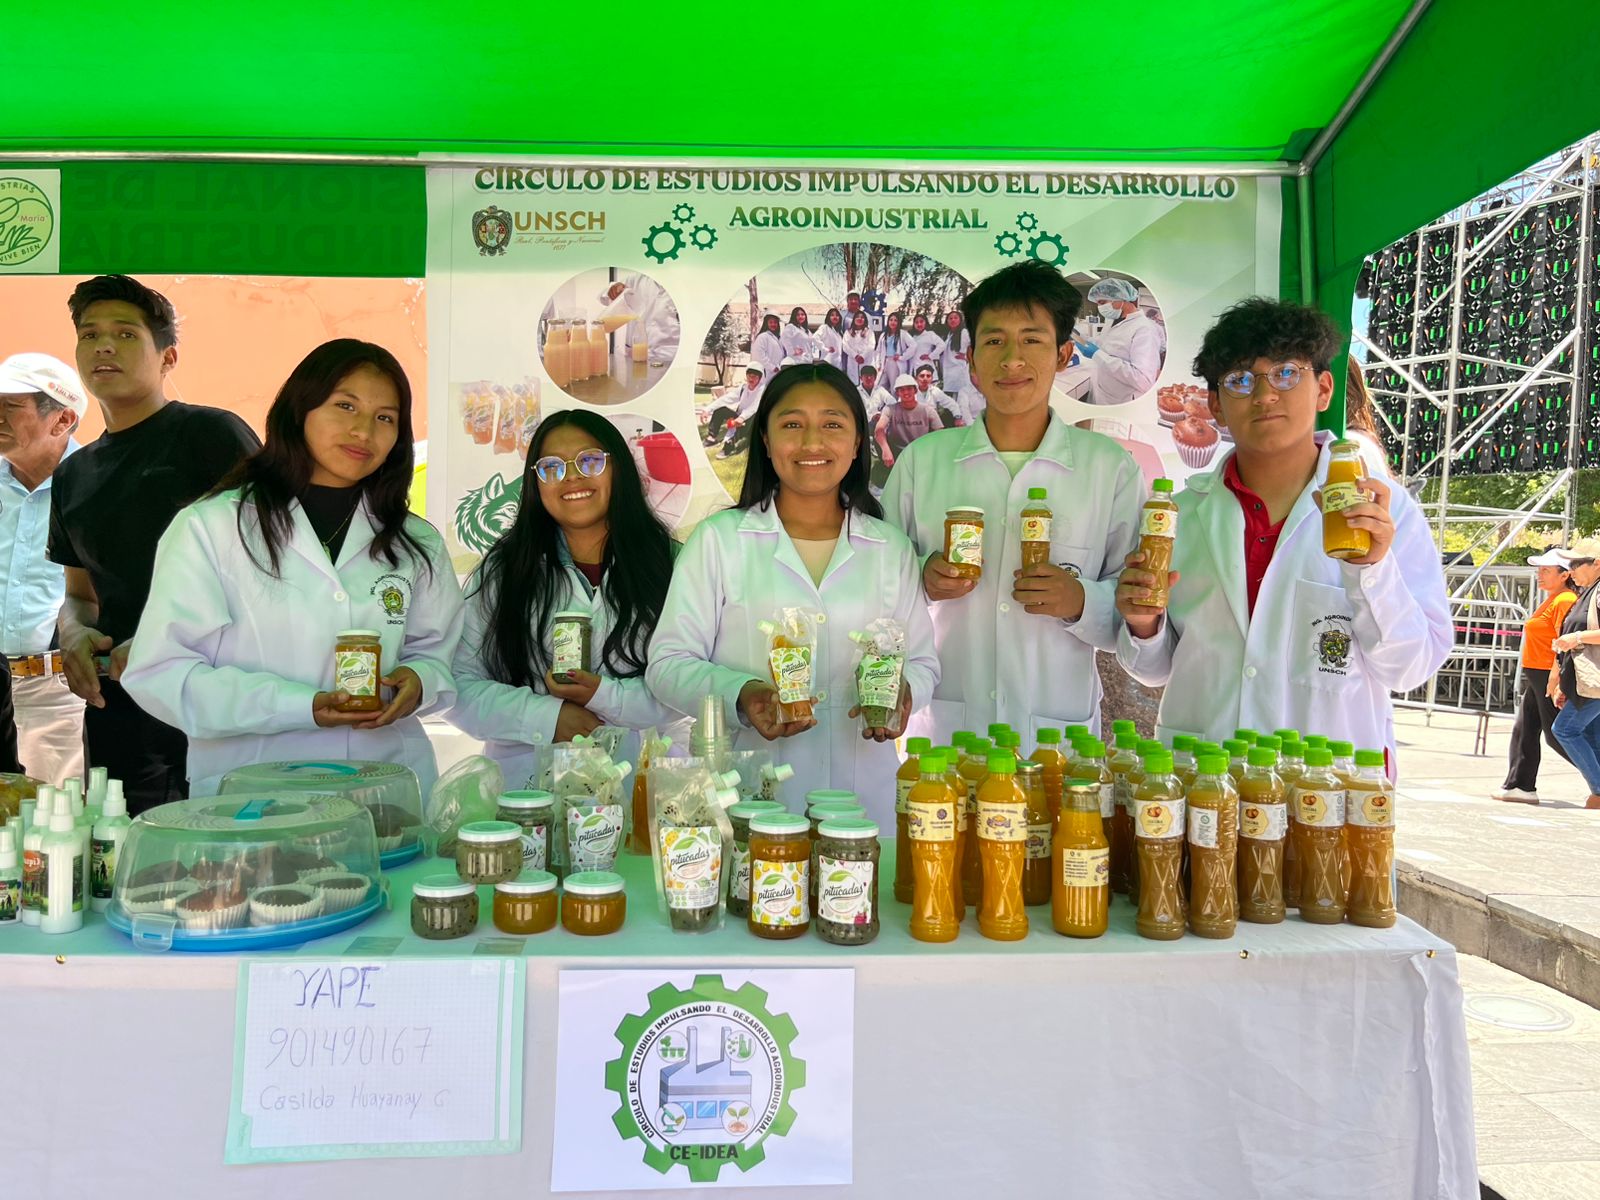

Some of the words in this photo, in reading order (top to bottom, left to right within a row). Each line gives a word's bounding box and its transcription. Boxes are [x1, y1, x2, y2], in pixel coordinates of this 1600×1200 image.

[612, 167, 650, 190] DE
[656, 168, 801, 192] ESTUDIOS
[808, 170, 999, 194] IMPULSANDO
[1005, 174, 1040, 195] EL
[1045, 174, 1236, 199] DESARROLLO
[514, 210, 606, 231] UNSCH
[729, 206, 988, 230] AGROINDUSTRIAL
[1318, 667, 1347, 676] UNSCH
[578, 824, 616, 846] pitucadas
[670, 847, 710, 867] pitucadas
[757, 884, 795, 904] pitucadas
[824, 884, 864, 902] pitucadas
[294, 966, 381, 1010] YAPE
[654, 1004, 711, 1031] IMPULSANDO
[716, 1005, 728, 1015] EL
[732, 1009, 777, 1054] DESARROLLO
[265, 1026, 433, 1070] 901490167
[630, 1029, 656, 1074] ESTUDIOS
[629, 1079, 637, 1094] DE
[754, 1055, 783, 1136] AGROINDUSTRIAL
[631, 1098, 655, 1139] CIRCULO
[669, 1144, 739, 1160] CE-IDEA
